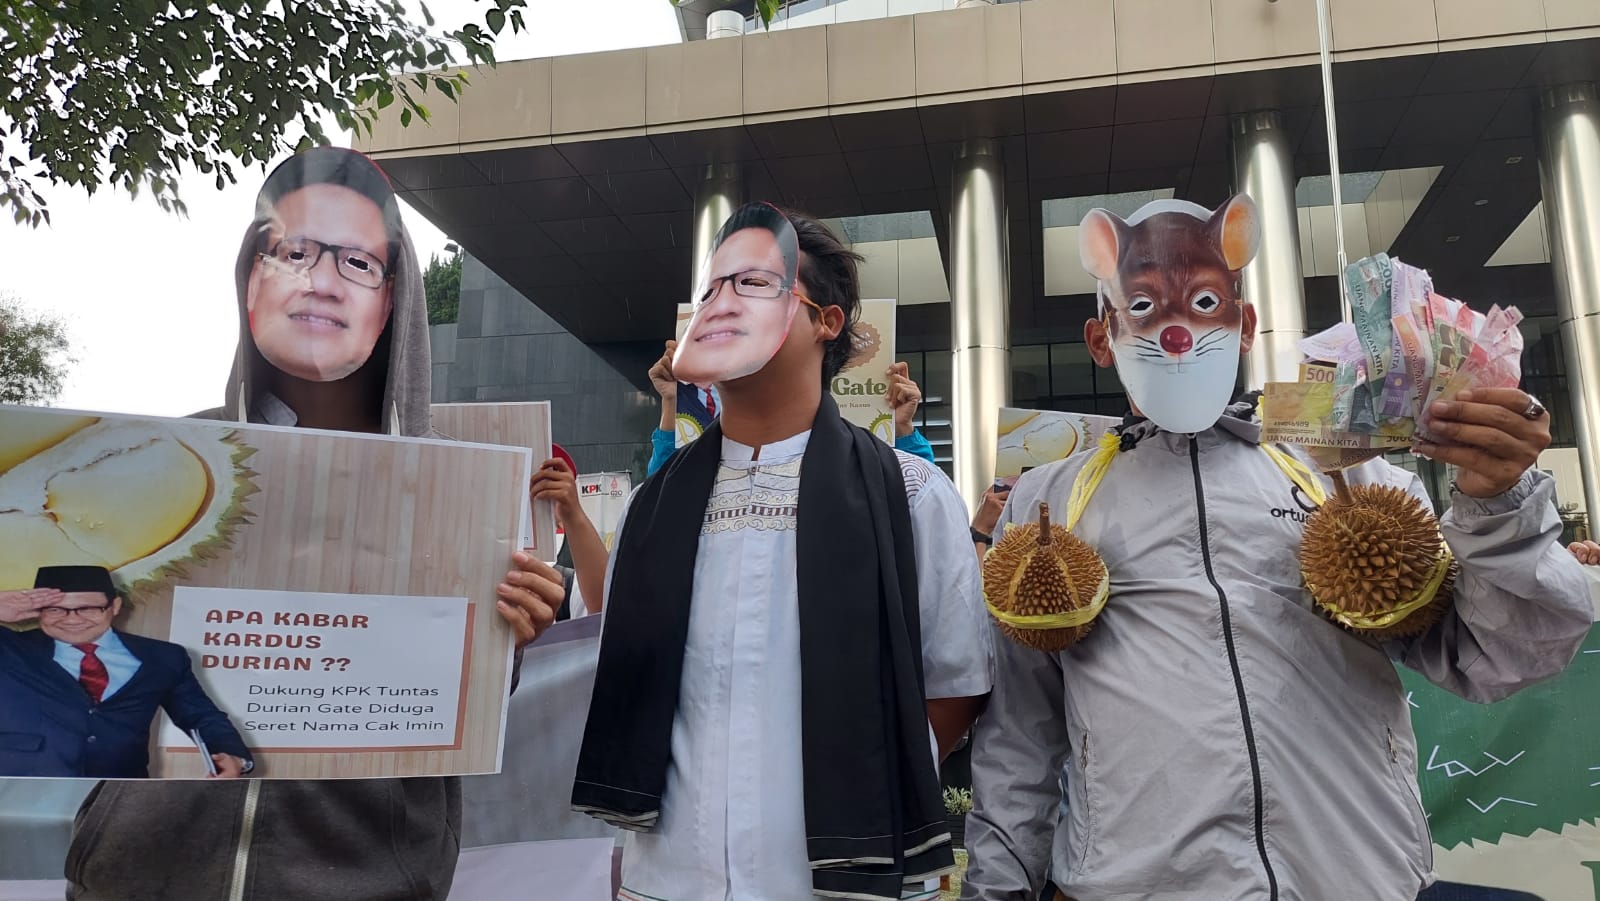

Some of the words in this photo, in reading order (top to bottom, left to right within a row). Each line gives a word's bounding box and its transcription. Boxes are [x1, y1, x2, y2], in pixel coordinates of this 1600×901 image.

[1374, 354, 1384, 376] KITA
[1391, 349, 1401, 369] KITA
[832, 377, 887, 395] Gate
[1266, 435, 1294, 443] UANG
[1295, 436, 1335, 446] MAINAN
[1336, 439, 1359, 447] KITA
[581, 484, 602, 495] KPK
[205, 609, 264, 625] APA
[273, 611, 369, 629] KABAR
[203, 632, 322, 649] KARDUS
[201, 654, 312, 671] DURIAN
[320, 657, 352, 672] ??
[248, 684, 325, 698] Dukung
[331, 686, 371, 696] KPK
[376, 685, 439, 697] Tuntas
[247, 702, 311, 713] Durian
[317, 703, 362, 714] Gate
[369, 702, 434, 716] Diduga
[244, 721, 296, 731] Seret
[303, 721, 359, 731] Nama
[365, 720, 400, 731] Cak
[405, 720, 444, 731] Imin
